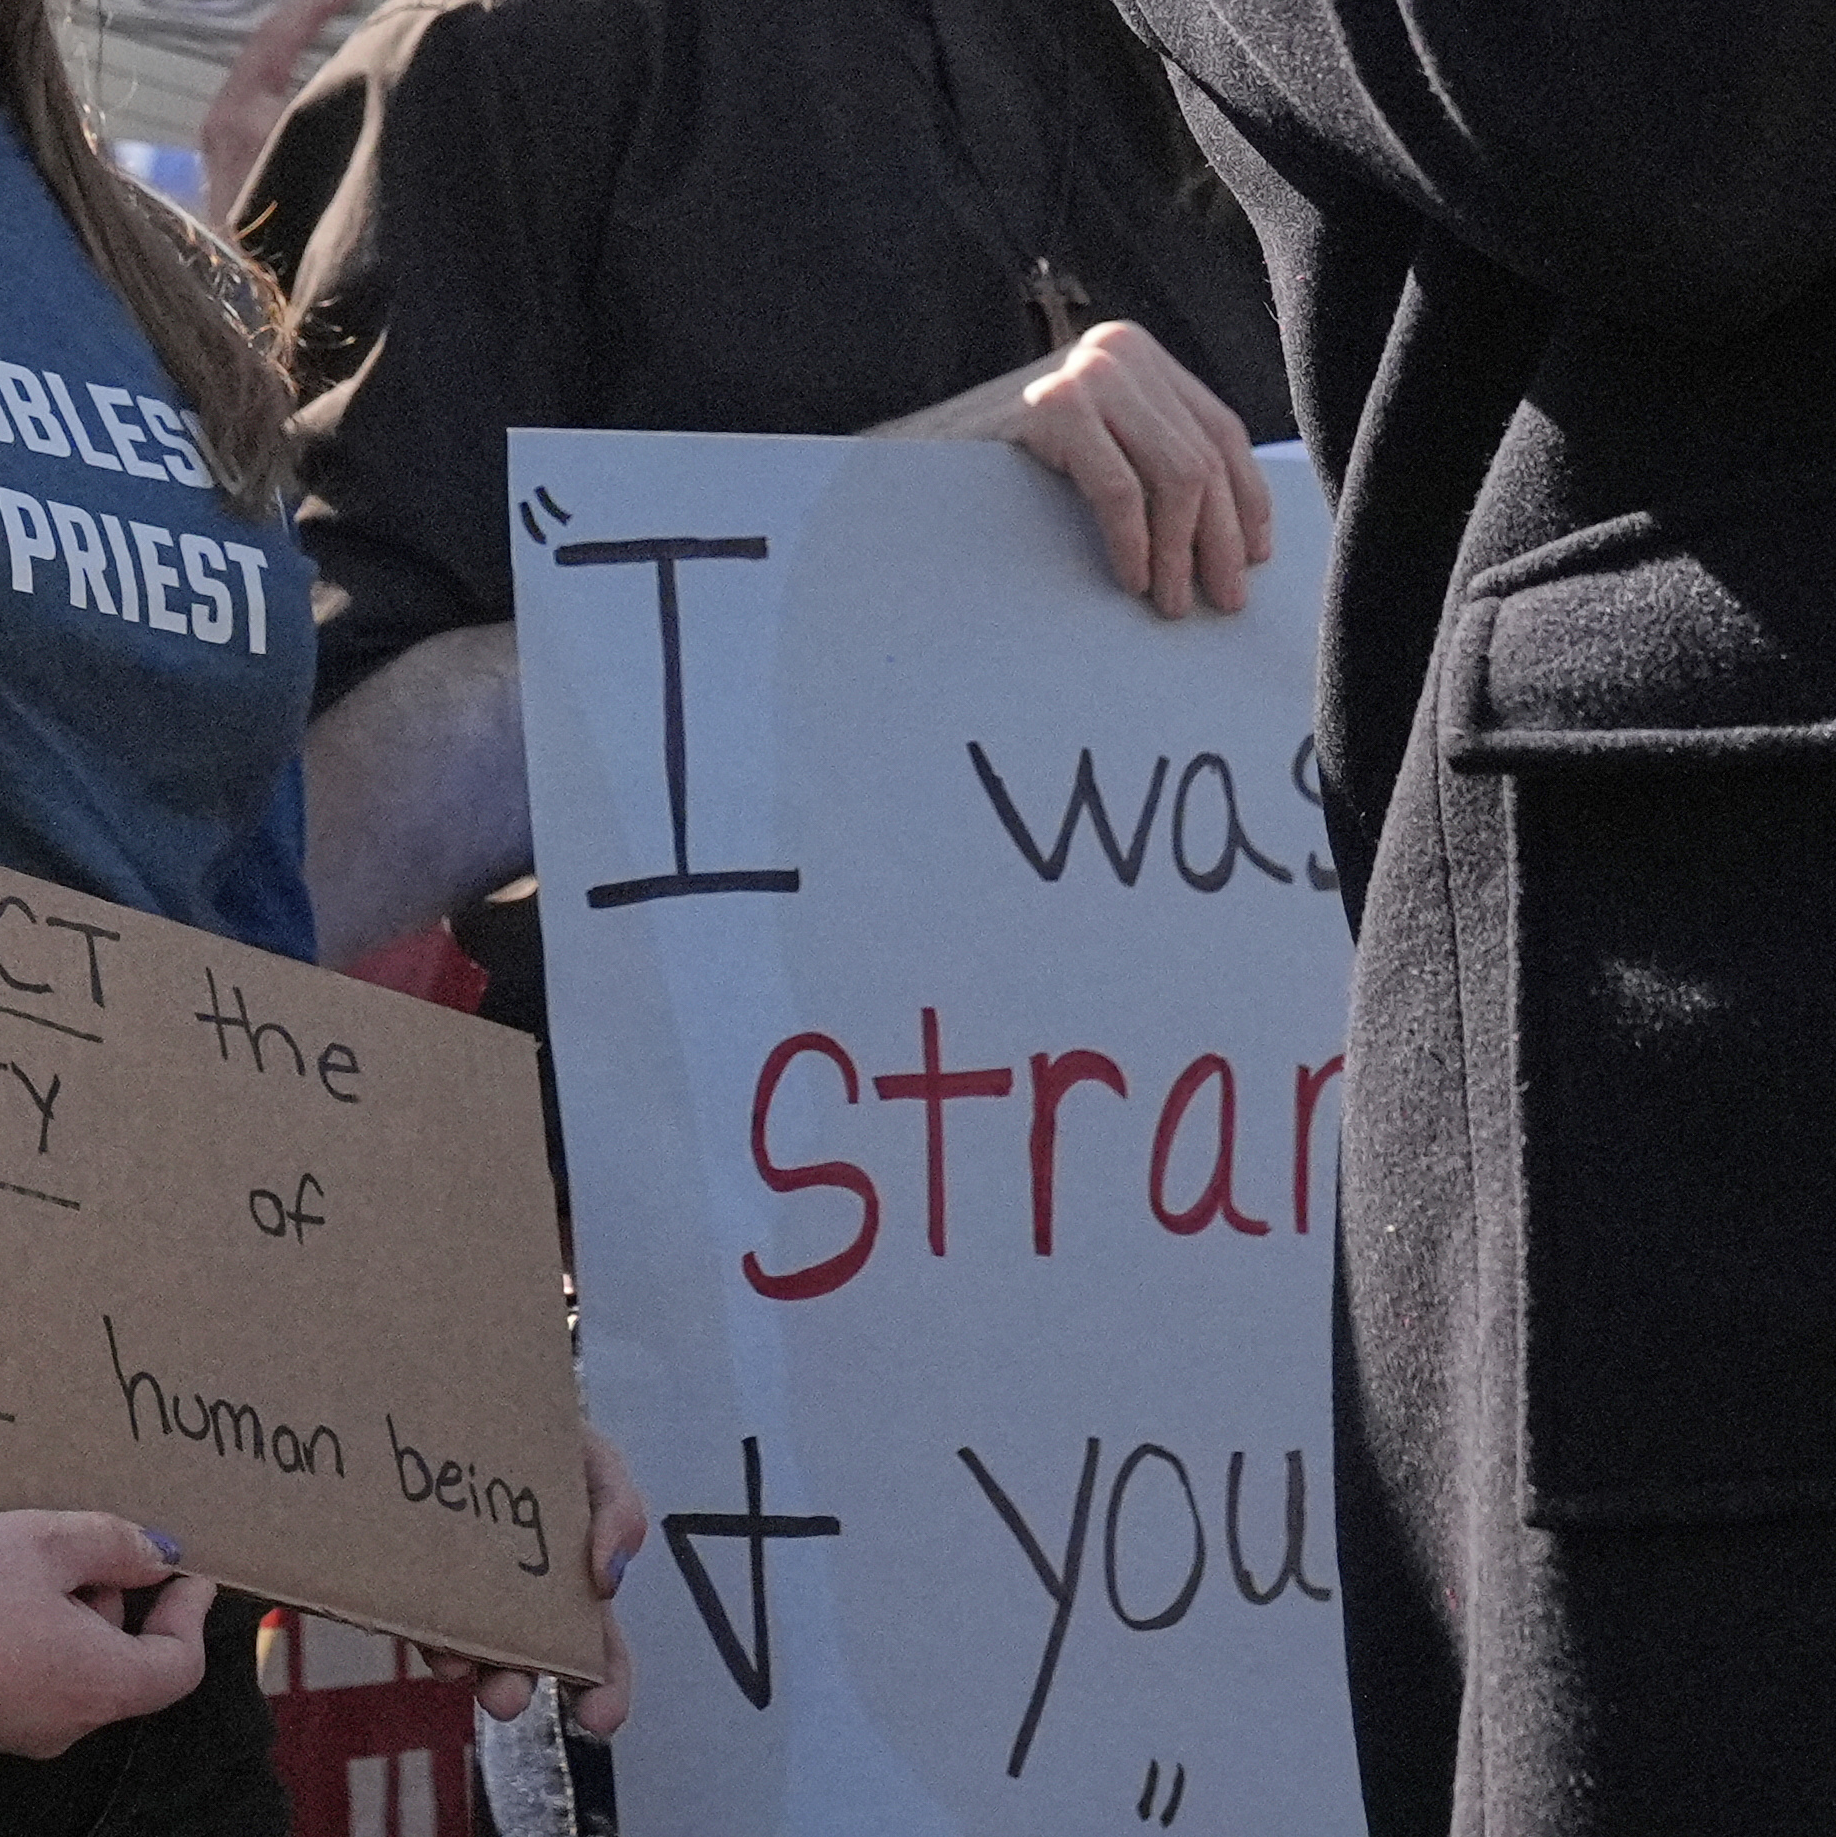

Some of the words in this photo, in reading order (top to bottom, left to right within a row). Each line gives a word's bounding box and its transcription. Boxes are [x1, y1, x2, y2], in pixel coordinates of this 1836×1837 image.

[193, 965, 362, 1104] the
[248, 1172, 326, 1243] of
[102, 1314, 347, 1479] human
[386, 1413, 552, 1577] being
[957, 1435, 1332, 1780] you
